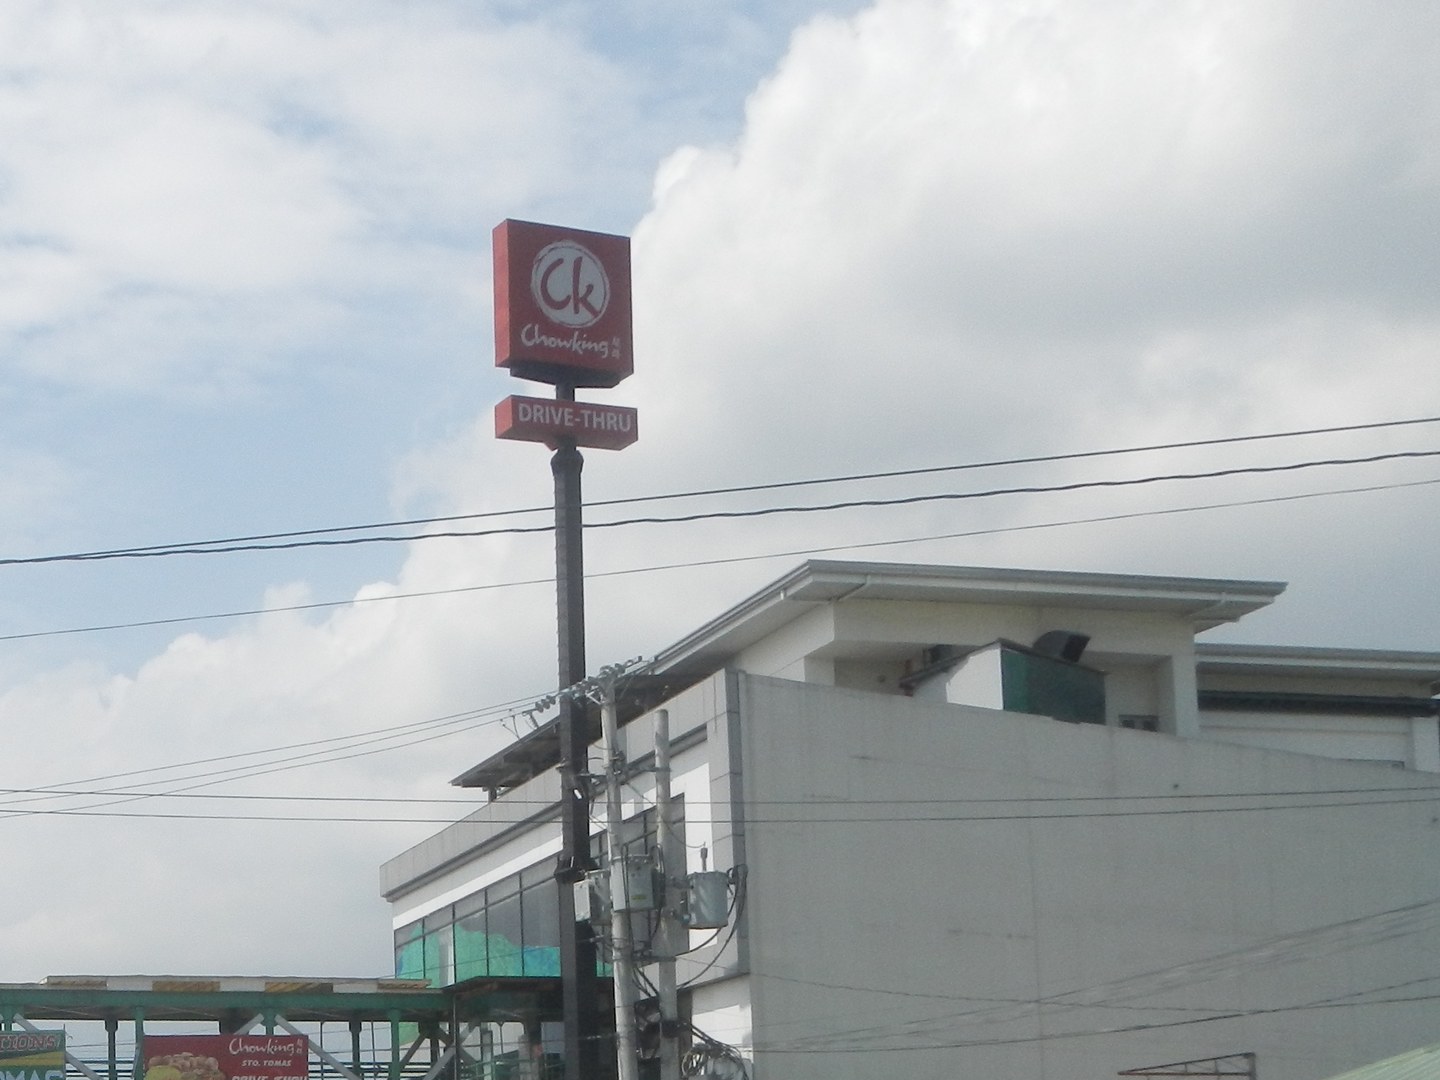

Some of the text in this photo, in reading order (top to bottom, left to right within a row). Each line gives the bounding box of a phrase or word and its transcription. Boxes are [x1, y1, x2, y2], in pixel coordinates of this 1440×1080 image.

[541, 257, 601, 318] Ck
[521, 323, 609, 358] Chowking
[518, 403, 632, 432] DRIVE-THRU
[229, 1038, 295, 1055] Chowking
[242, 1059, 292, 1067] STO. TOMAS
